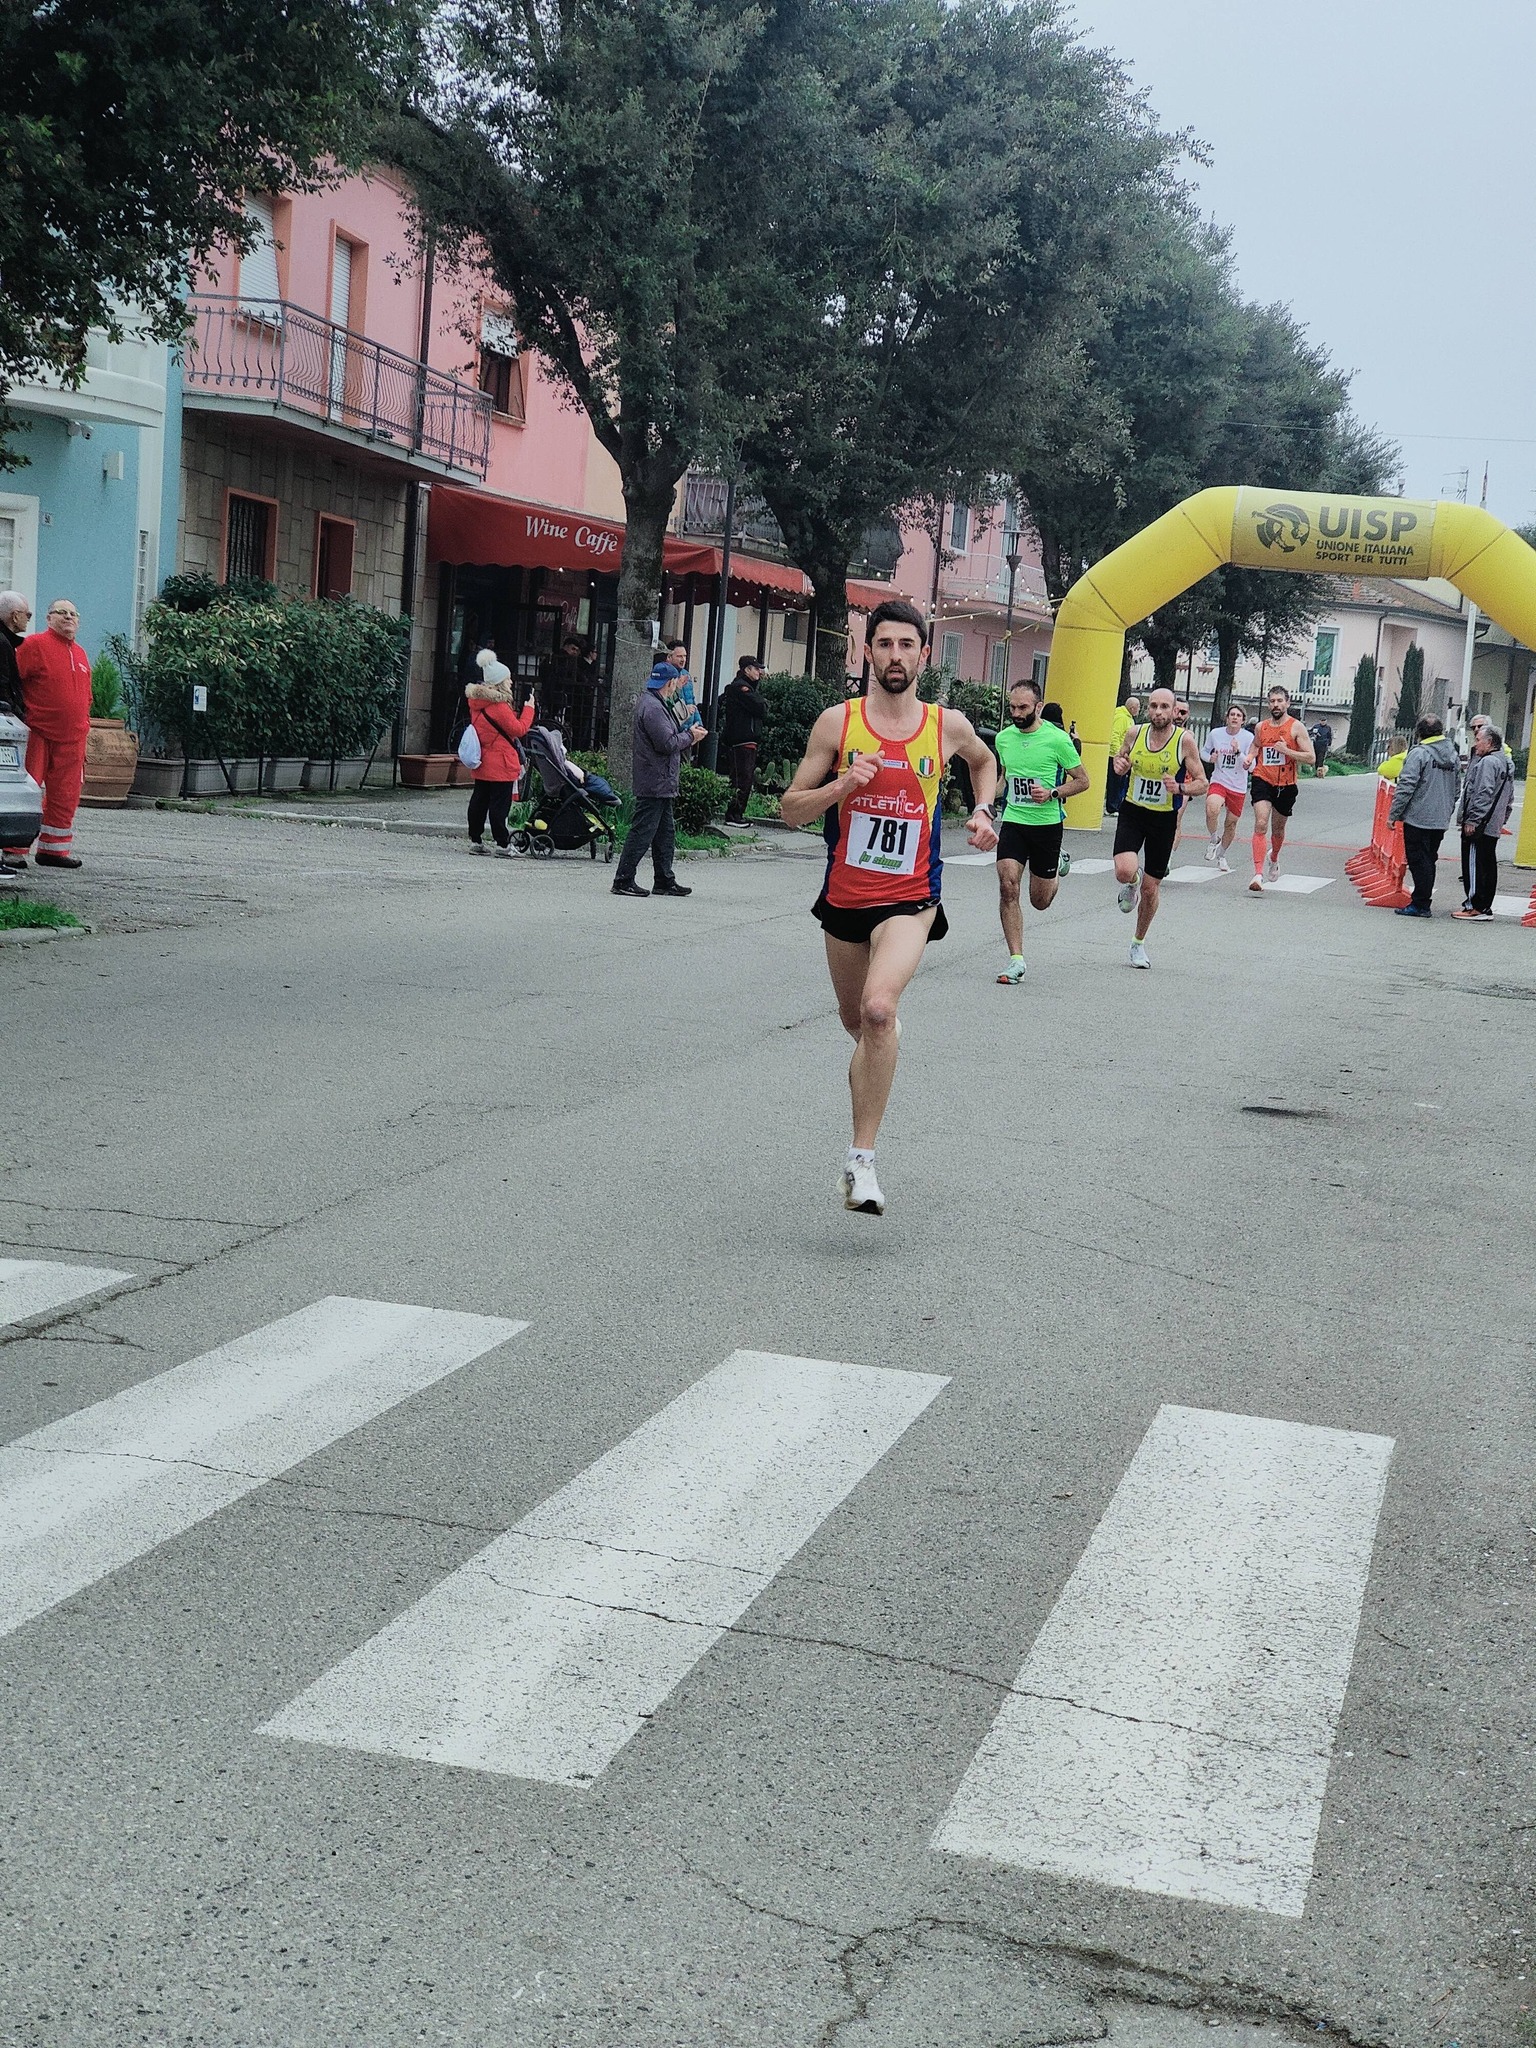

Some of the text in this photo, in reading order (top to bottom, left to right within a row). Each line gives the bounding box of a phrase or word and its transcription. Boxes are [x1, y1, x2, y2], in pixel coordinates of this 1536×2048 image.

[1318, 506, 1418, 542] UISP
[525, 515, 619, 555] Wine Caffè
[1316, 539, 1414, 556] UNIONE ITALIANA
[1315, 551, 1408, 566] SPORT PER TUTTI
[1222, 753, 1236, 765] 795
[1139, 778, 1162, 797] 792
[866, 816, 909, 856] 781
